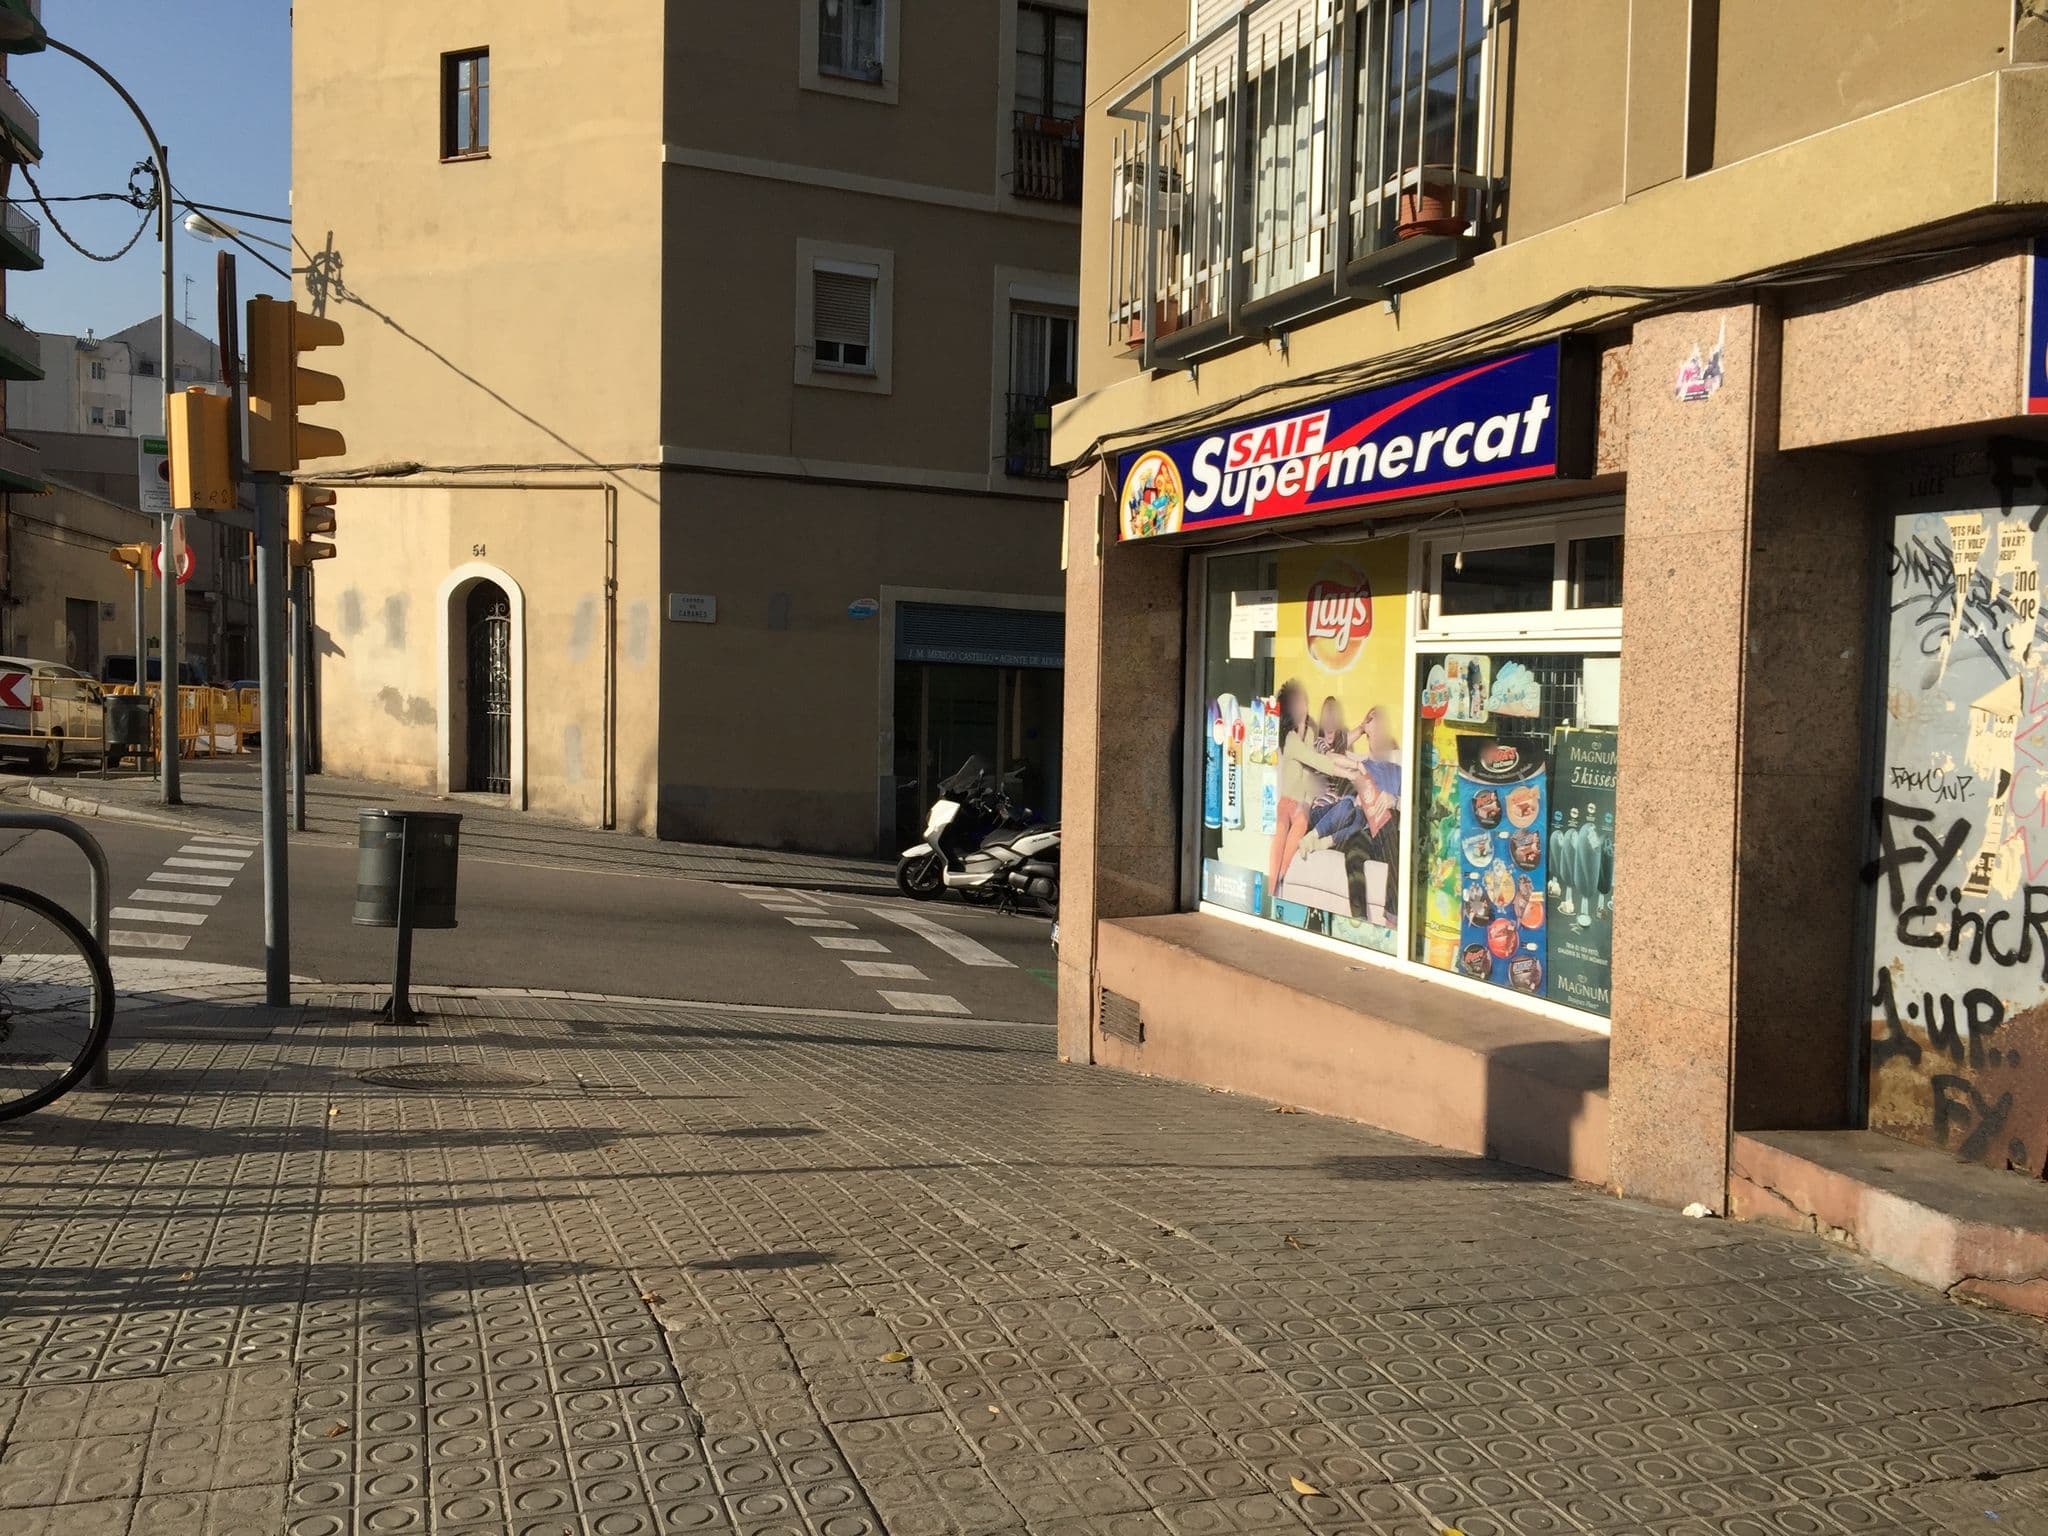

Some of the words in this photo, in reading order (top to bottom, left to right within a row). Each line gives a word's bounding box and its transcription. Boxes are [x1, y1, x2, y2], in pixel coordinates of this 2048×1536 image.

[1185, 394, 1551, 516] Supermercat
[1230, 414, 1325, 469] SAIF
[472, 544, 487, 557] 54
[1571, 766, 1581, 784] 5
[1581, 767, 1617, 787] kisses
[1557, 974, 1609, 1004] MAGNUM
